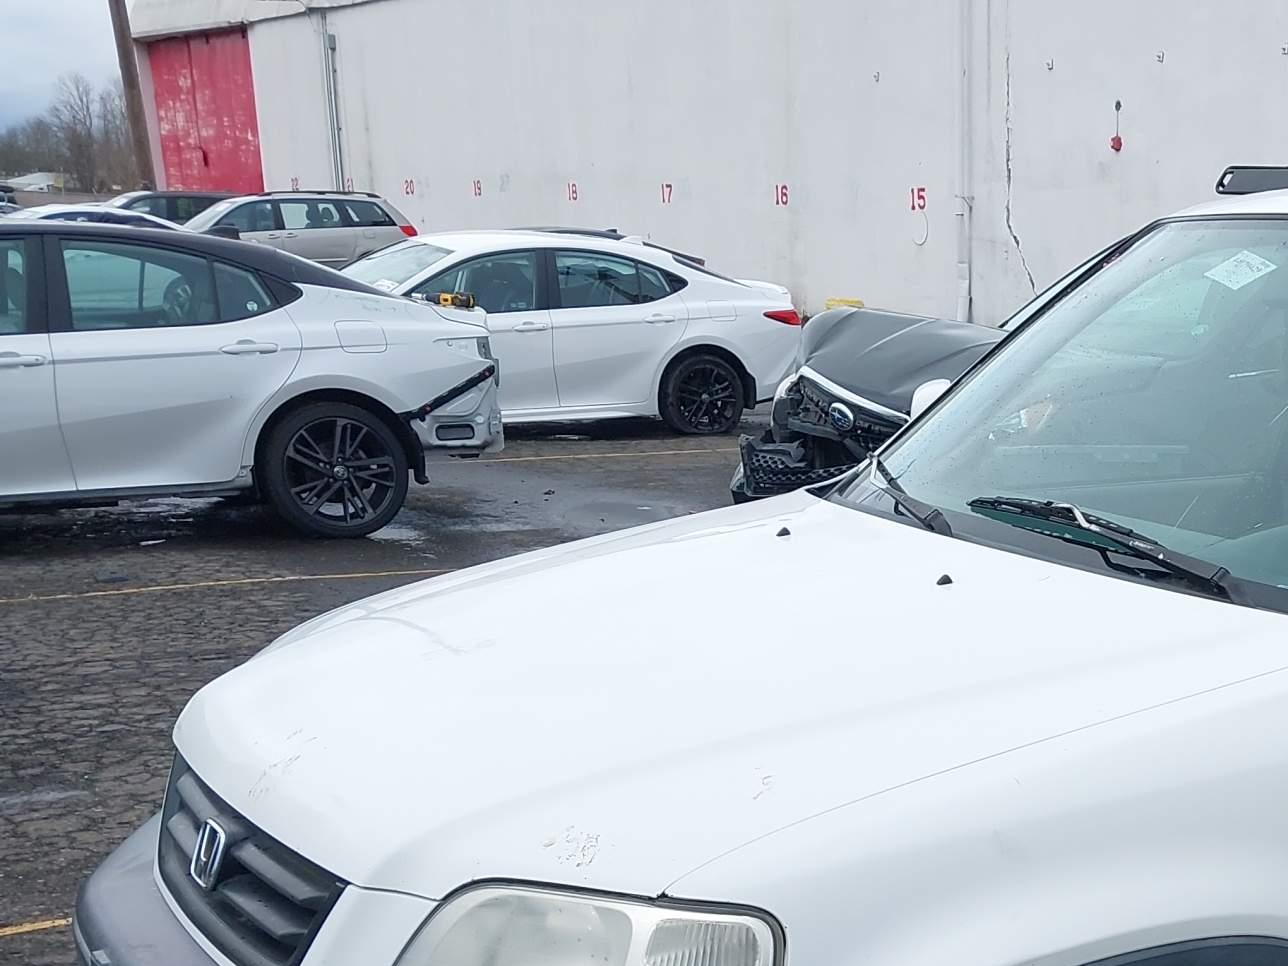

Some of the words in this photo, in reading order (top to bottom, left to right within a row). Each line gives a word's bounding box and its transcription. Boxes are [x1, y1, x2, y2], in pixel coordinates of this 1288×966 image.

[405, 180, 415, 195] 20
[473, 180, 482, 196] 19
[567, 183, 578, 201] 18
[661, 183, 673, 204] 17
[775, 184, 789, 205] 16
[911, 187, 926, 211] 15
